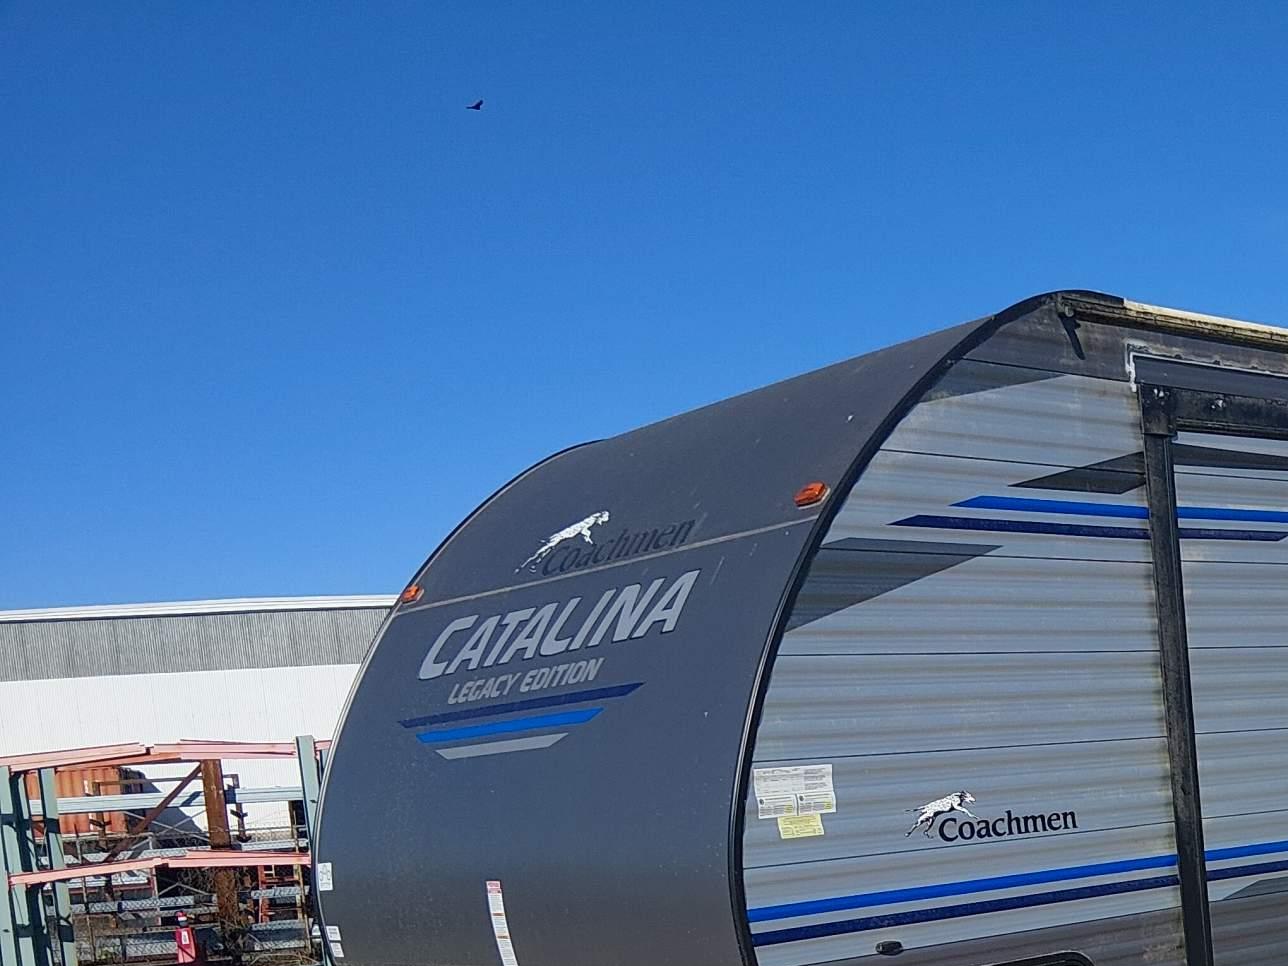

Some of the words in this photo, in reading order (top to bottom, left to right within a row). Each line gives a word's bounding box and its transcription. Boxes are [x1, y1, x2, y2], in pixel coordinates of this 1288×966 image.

[541, 519, 696, 577] Coachmen
[417, 568, 702, 681] CATALINA
[447, 672, 522, 705] LEGACY
[519, 657, 606, 694] EDITION
[938, 809, 1079, 842] Coachmen
